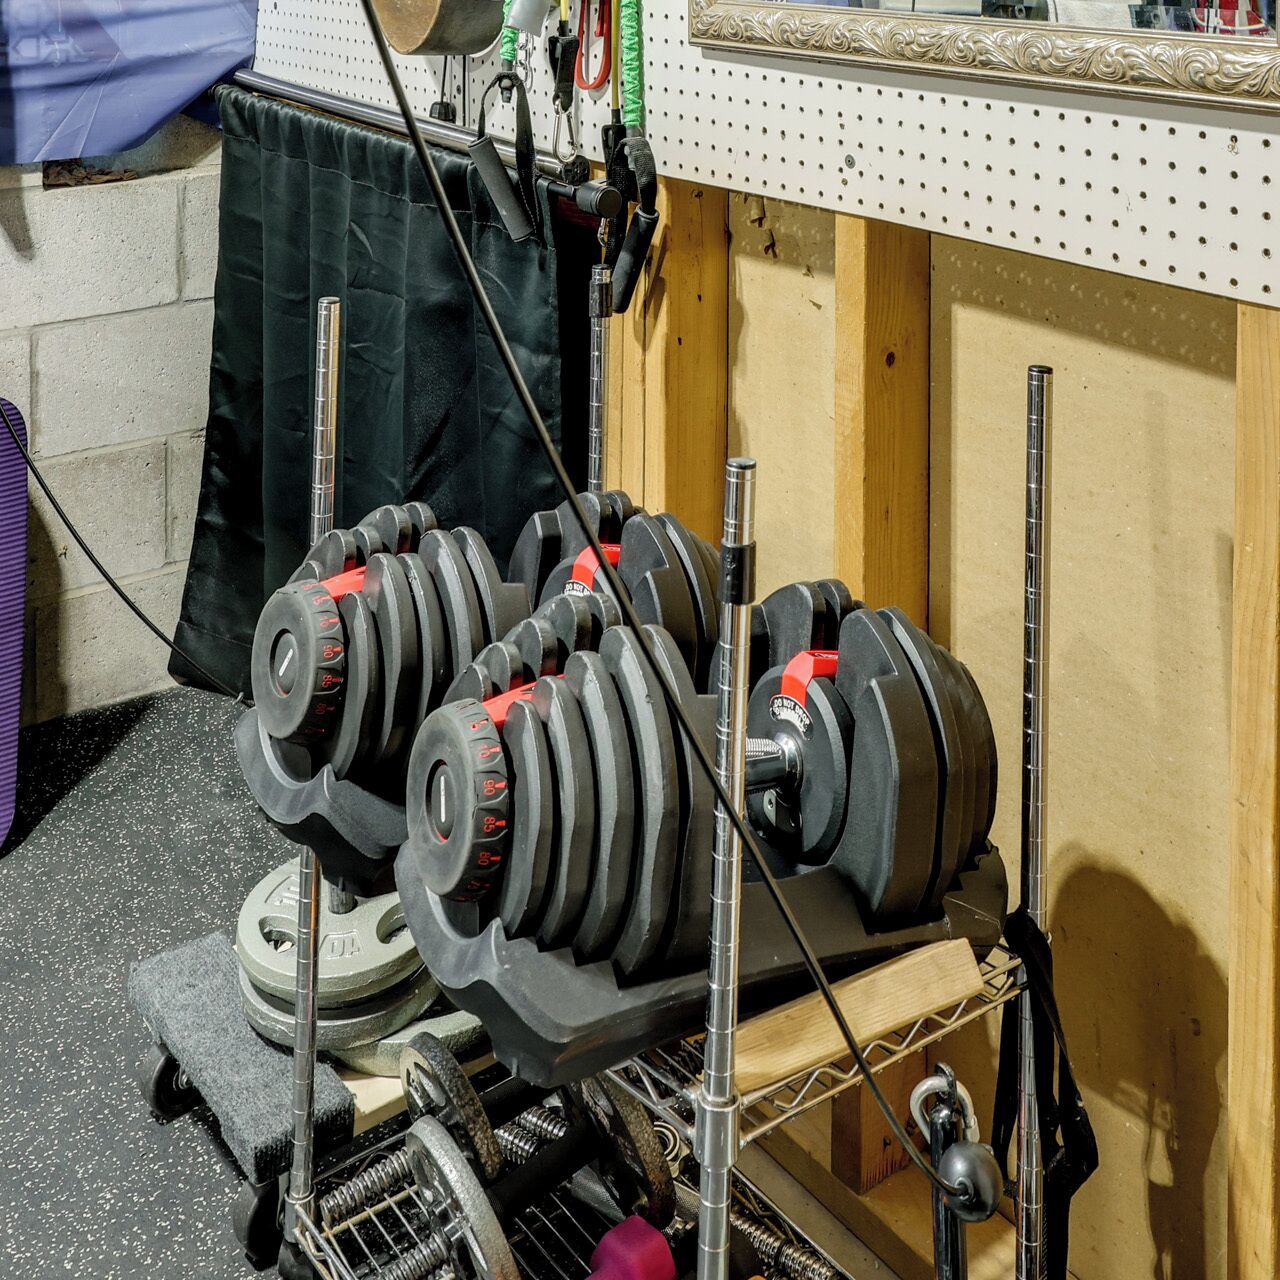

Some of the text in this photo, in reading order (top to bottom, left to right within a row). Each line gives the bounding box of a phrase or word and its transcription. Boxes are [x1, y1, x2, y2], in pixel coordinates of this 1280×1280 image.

[323, 645, 334, 659] 90
[322, 673, 333, 689] 85
[773, 698, 782, 707] DO
[783, 698, 795, 709] NOT
[795, 705, 810, 725] DROP
[478, 745, 491, 759] 10
[483, 778, 496, 796] 90
[483, 815, 496, 833] 85
[478, 851, 491, 866] 80
